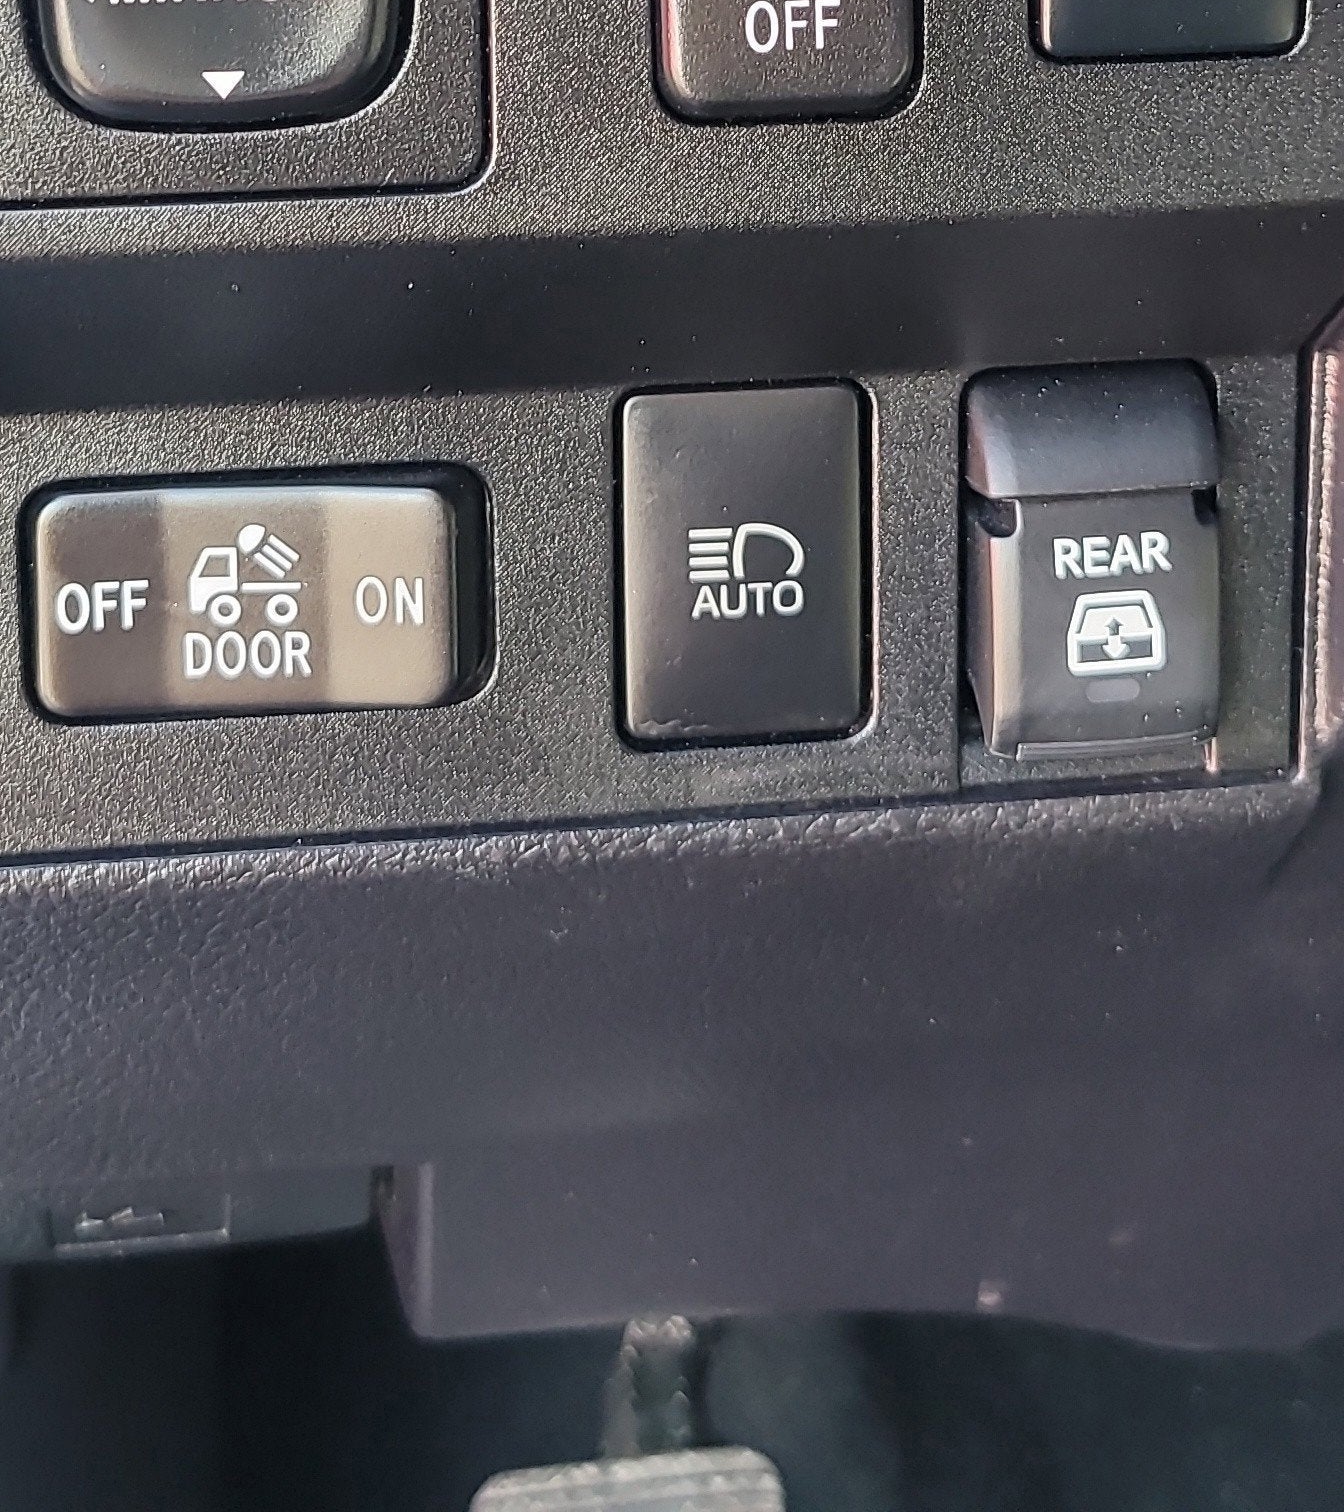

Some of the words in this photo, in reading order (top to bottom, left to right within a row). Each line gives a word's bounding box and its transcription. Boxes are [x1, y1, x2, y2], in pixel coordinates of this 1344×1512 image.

[1052, 531, 1173, 580] REAR
[56, 579, 149, 634] OFF
[355, 576, 425, 626] ON
[691, 580, 805, 620] AUTO
[183, 630, 312, 679] DOOR
